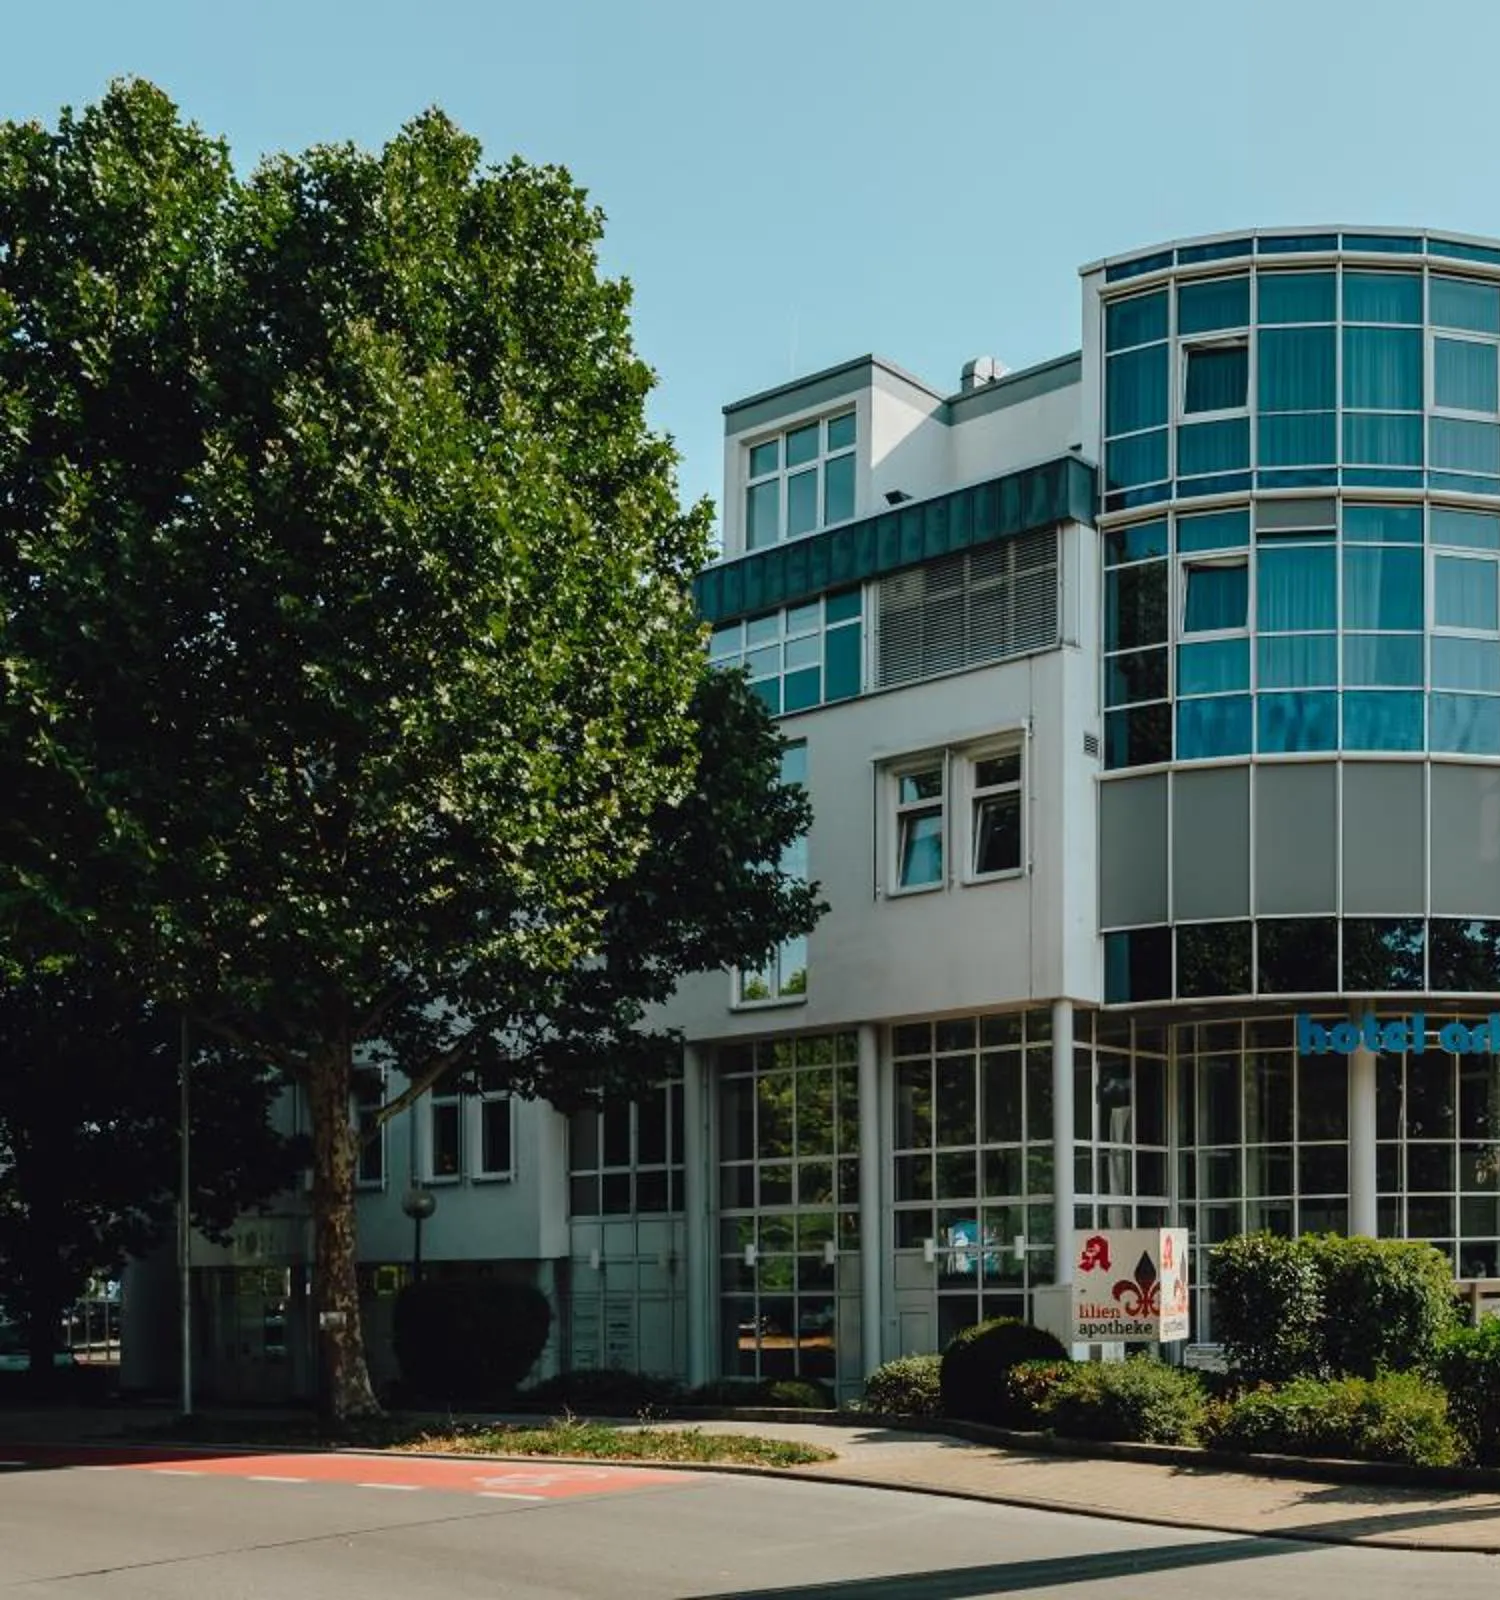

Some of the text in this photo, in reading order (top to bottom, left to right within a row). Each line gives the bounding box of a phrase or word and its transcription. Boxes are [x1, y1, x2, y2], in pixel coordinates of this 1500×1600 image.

[1298, 1010, 1425, 1056] hotel
[1079, 1302, 1121, 1319] lilien
[1079, 1320, 1153, 1339] apotheke
